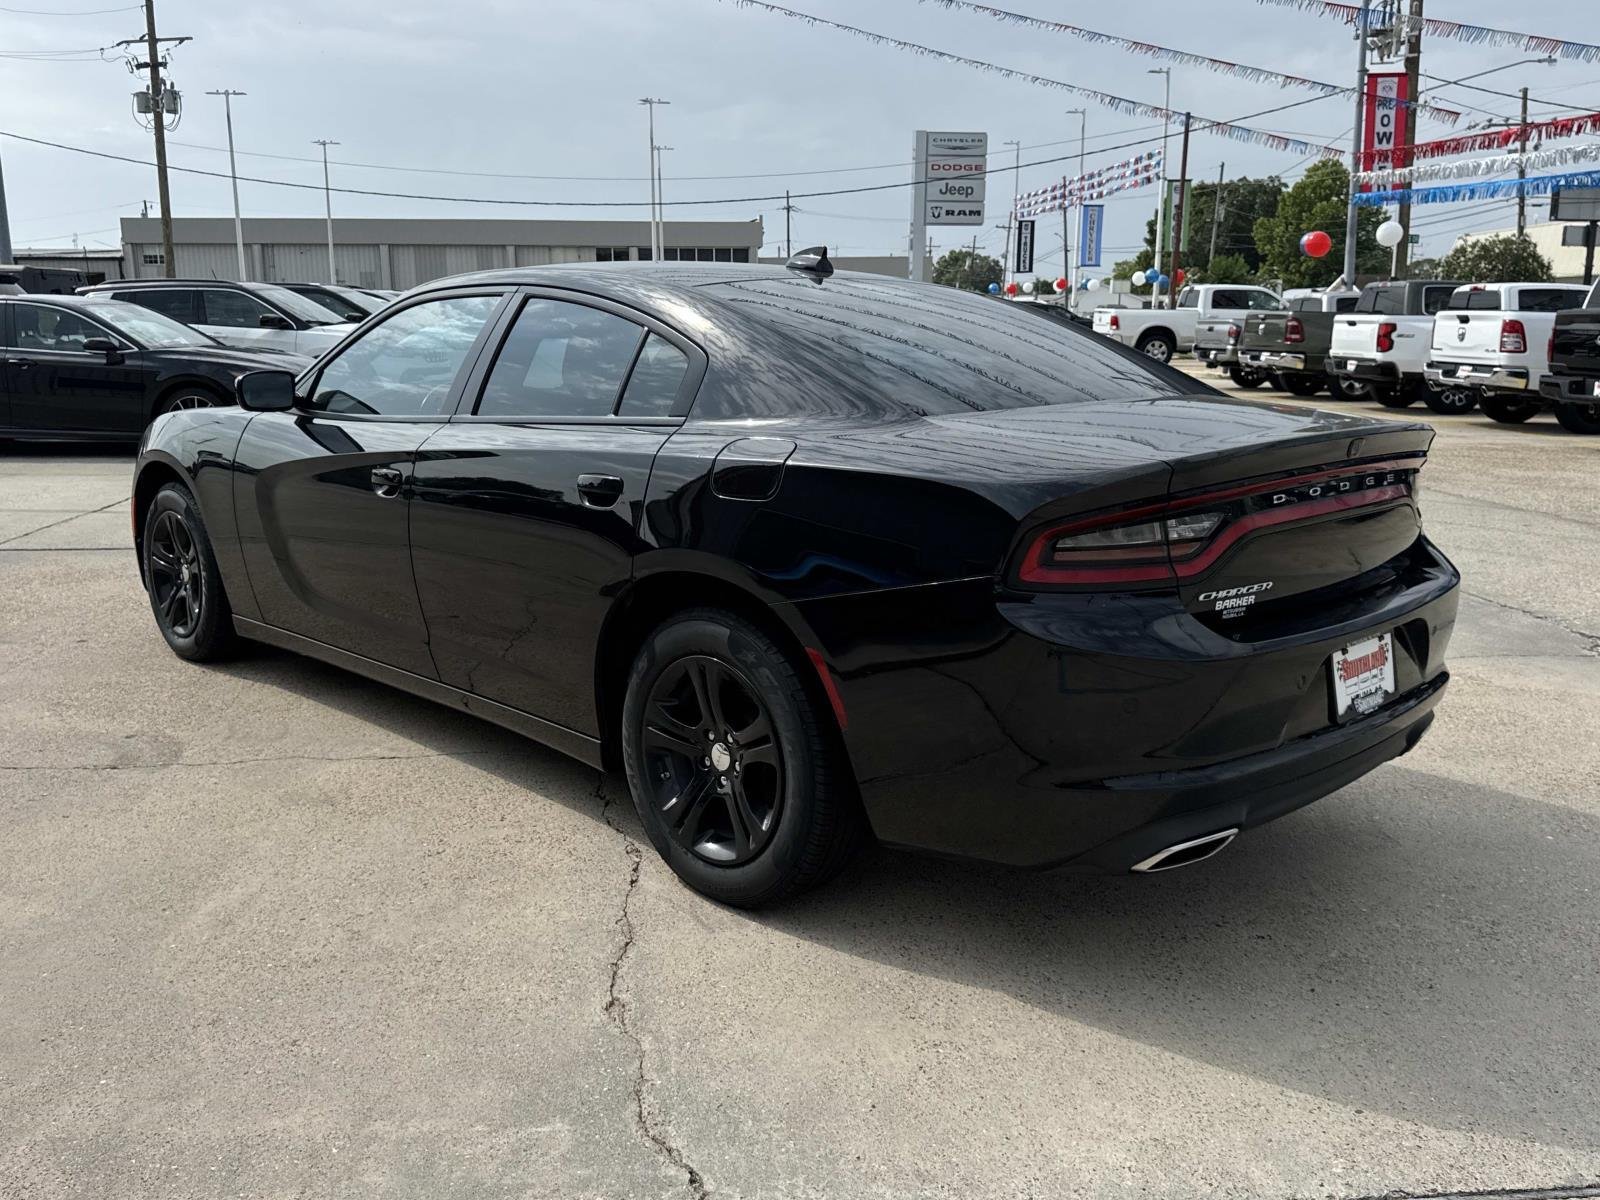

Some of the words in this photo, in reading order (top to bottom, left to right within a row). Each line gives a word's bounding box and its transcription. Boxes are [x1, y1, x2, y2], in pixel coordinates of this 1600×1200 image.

[931, 163, 985, 172] DODGE
[939, 182, 974, 198] Jeep
[945, 209, 982, 217] RAM
[1272, 473, 1395, 505] DODGE
[1198, 581, 1274, 602] CHARGER
[1215, 595, 1256, 611] BARKER
